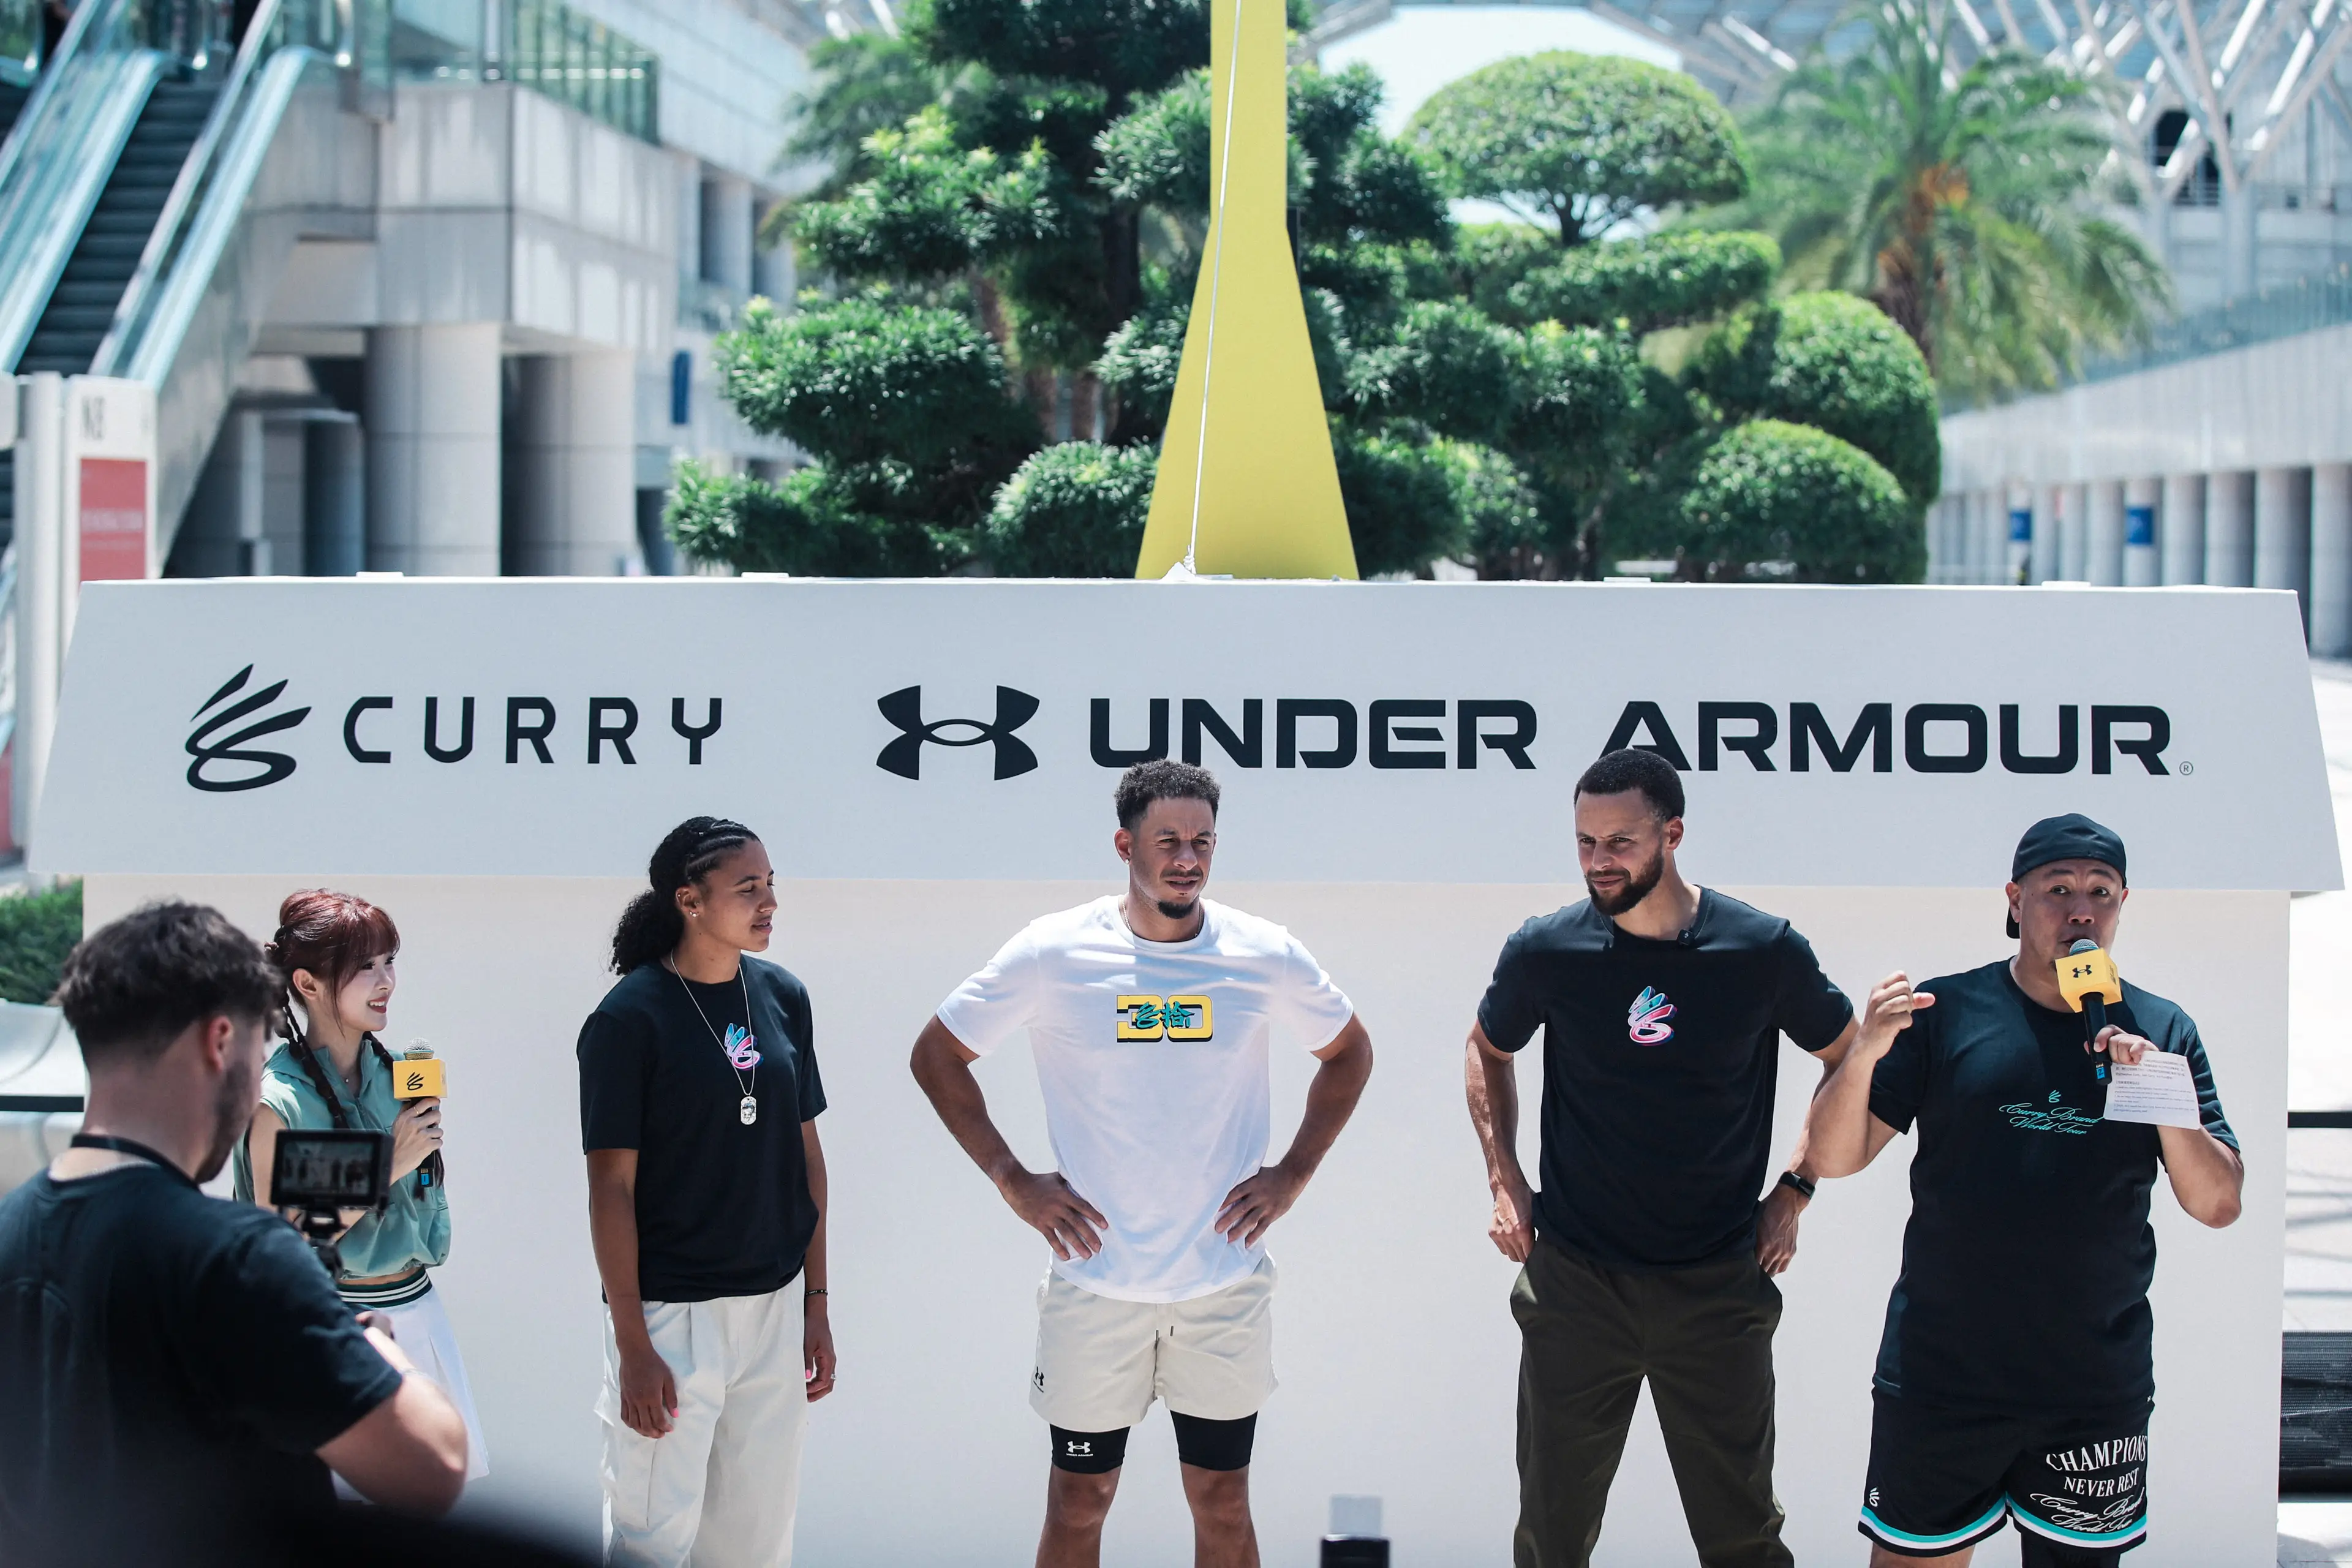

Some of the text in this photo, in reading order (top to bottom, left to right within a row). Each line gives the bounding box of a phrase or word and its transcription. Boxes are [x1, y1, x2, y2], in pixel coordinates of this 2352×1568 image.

[343, 696, 722, 765] CURRY
[1090, 698, 1538, 769] UNDER
[1117, 993, 1213, 1042] 30
[1999, 1102, 2105, 1123] Curry Brand
[2009, 1116, 2094, 1135] World Tour
[2046, 1435, 2147, 1471] CHAMPIONS
[2064, 1467, 2139, 1498] NEVER REST
[2030, 1487, 2145, 1521] Curry Brand
[2051, 1513, 2136, 1533] World Tour
